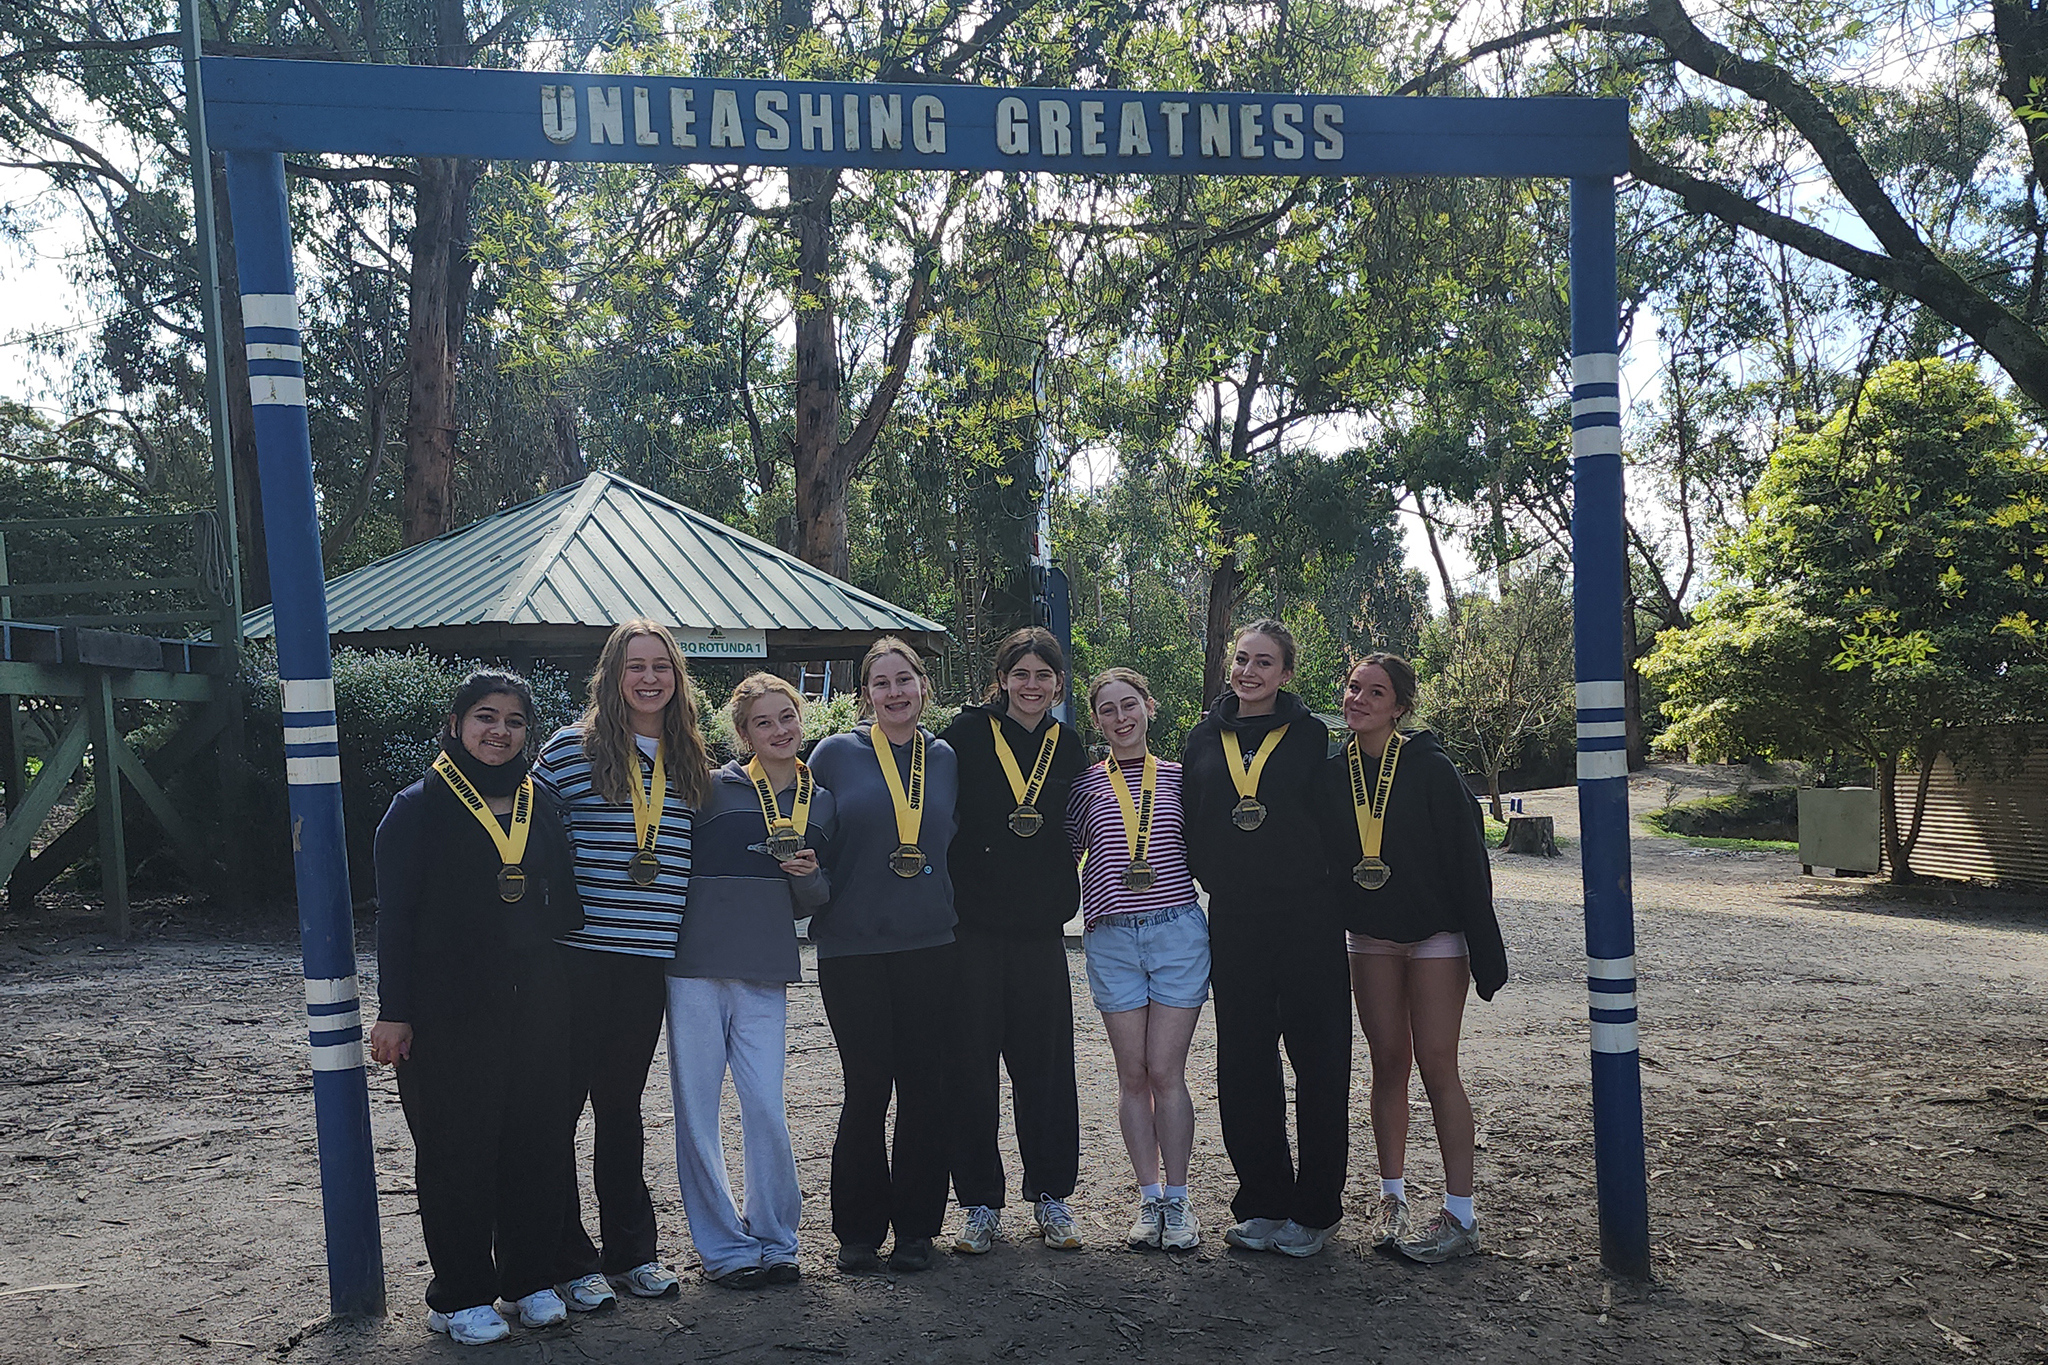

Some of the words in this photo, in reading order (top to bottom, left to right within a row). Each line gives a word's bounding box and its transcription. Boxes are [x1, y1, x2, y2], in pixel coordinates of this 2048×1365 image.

[540, 84, 946, 155] UNLEASHING
[996, 97, 1344, 161] GREATNESS
[676, 642, 697, 654] BQ
[698, 642, 754, 653] ROTUNDA
[755, 643, 761, 653] 1
[913, 731, 924, 772] SURVIVO
[1033, 737, 1055, 781] SURVIVOR
[442, 764, 484, 812] SURVIVOR
[910, 771, 922, 810] SUMMIT
[1350, 757, 1366, 807] SURVIVOR
[1373, 779, 1389, 820] SUMMIT
[515, 785, 530, 825] SUMMIT
[1138, 789, 1153, 833] SURVIVOR
